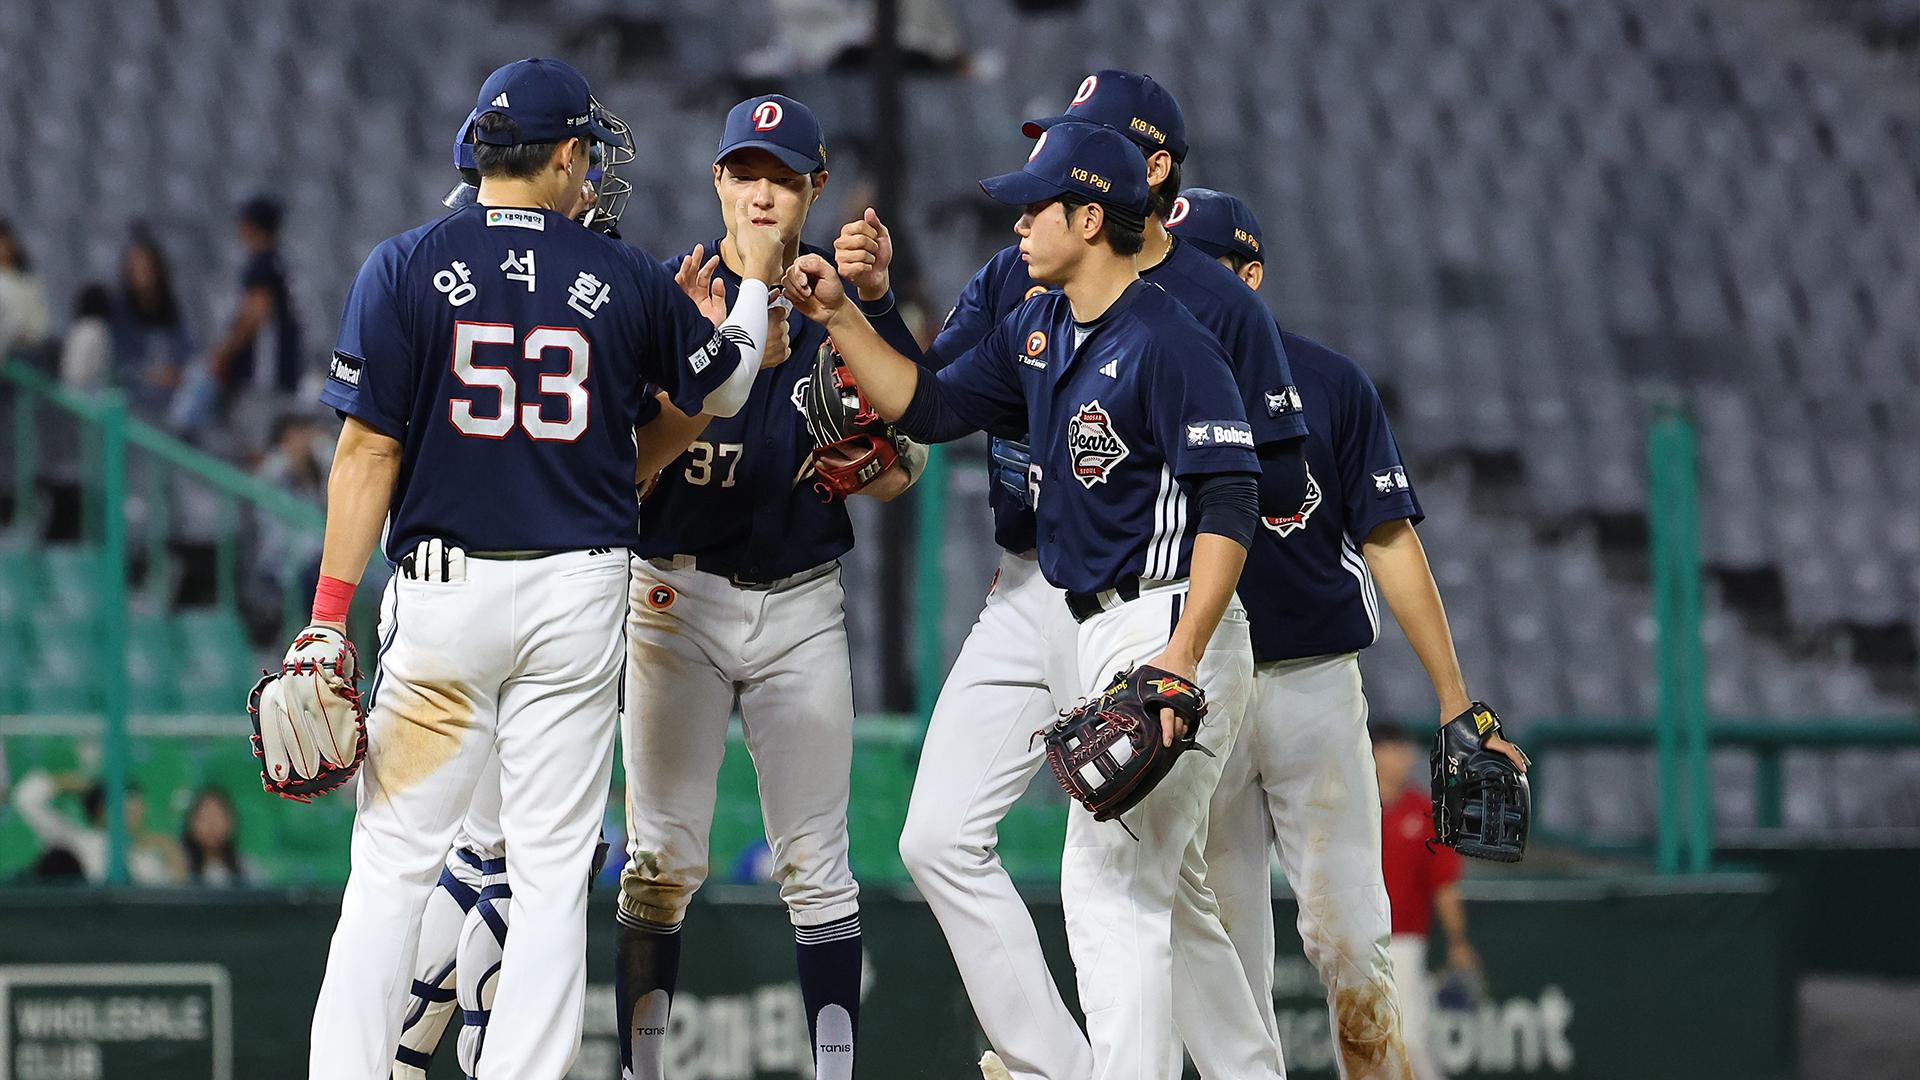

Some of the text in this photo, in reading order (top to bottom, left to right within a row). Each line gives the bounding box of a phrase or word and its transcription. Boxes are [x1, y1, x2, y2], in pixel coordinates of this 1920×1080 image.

[752, 101, 784, 132] D
[1131, 117, 1166, 144] KB Pay
[1071, 168, 1112, 193] KB Pay
[1235, 228, 1260, 252] KB Pay
[694, 355, 707, 369] EST
[449, 320, 591, 444] 53
[1069, 420, 1121, 453] Bears
[684, 441, 744, 488] 37
